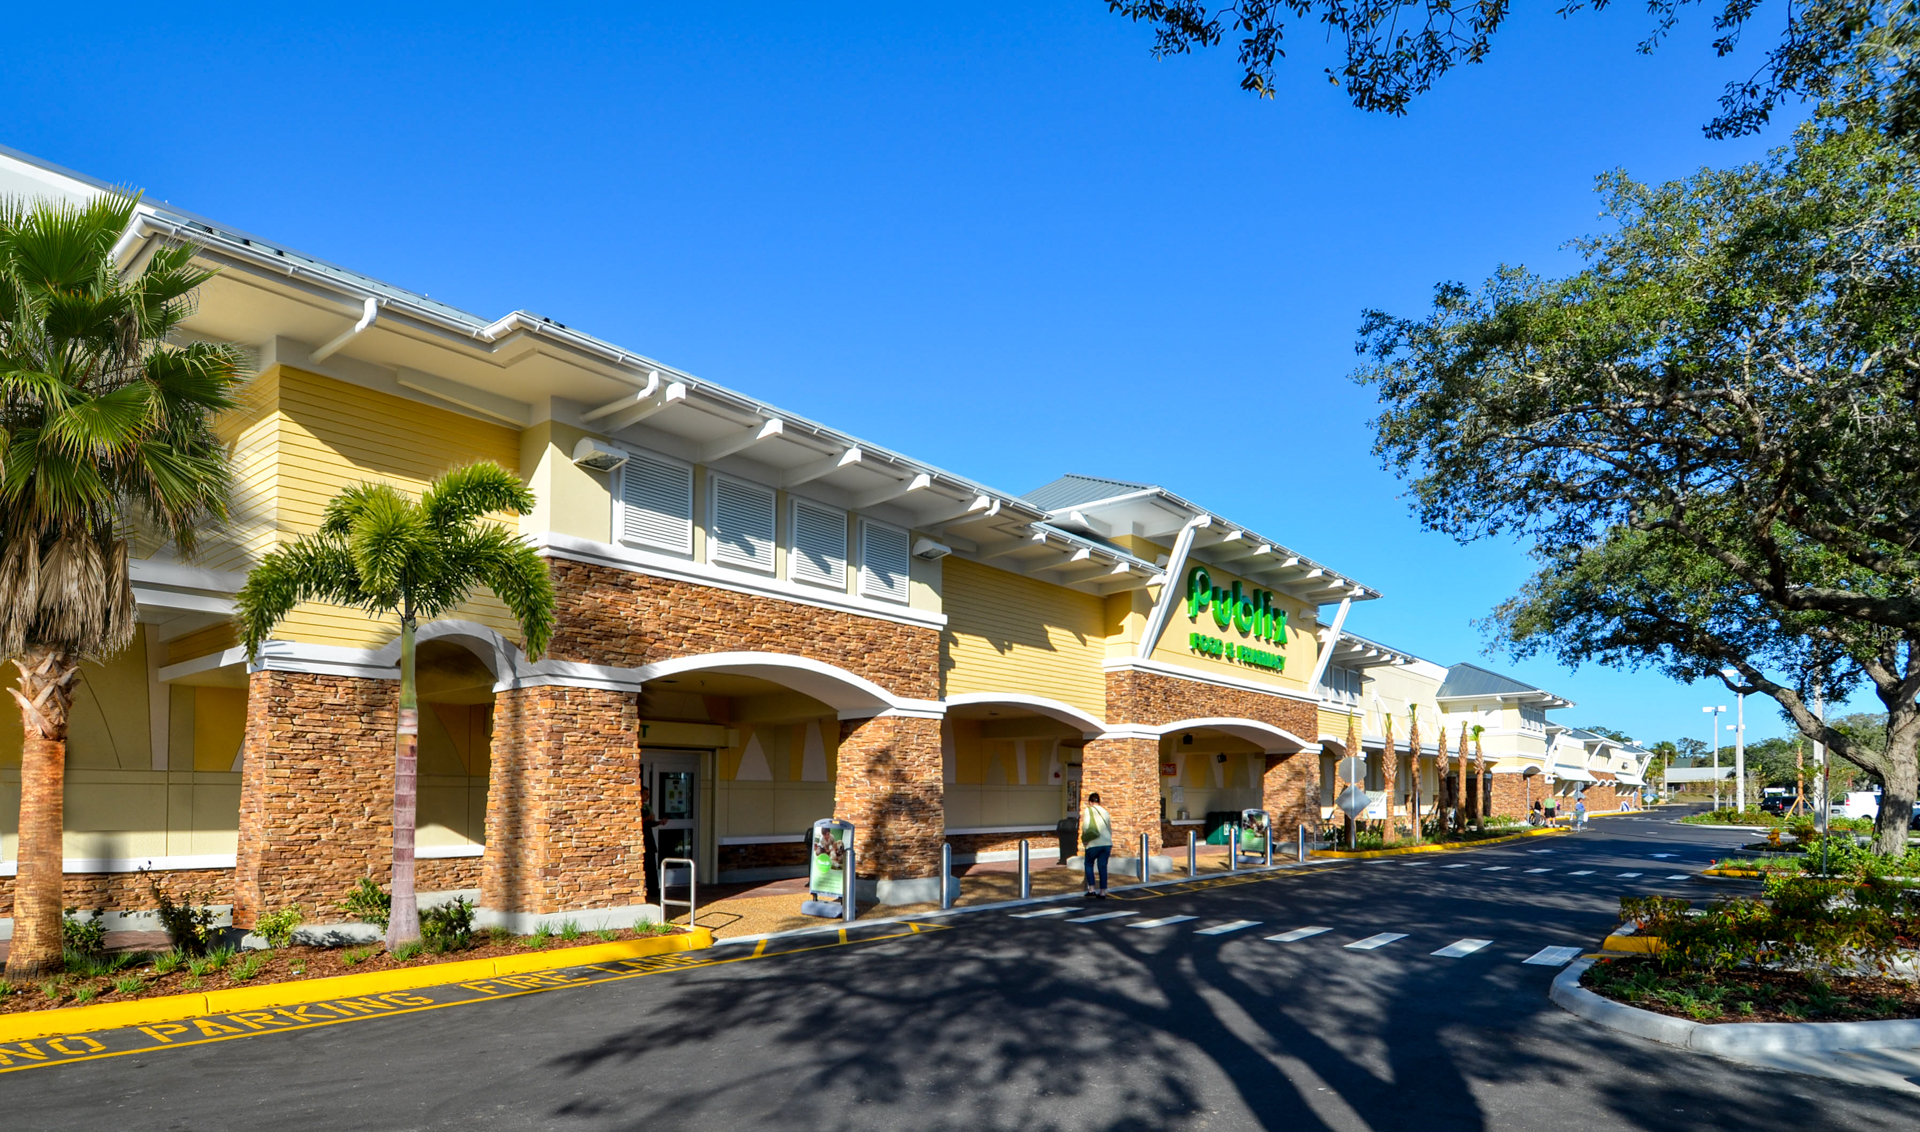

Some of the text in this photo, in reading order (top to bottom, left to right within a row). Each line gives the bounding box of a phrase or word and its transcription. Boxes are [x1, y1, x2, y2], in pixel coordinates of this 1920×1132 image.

[1187, 566, 1289, 645] Publix
[1189, 632, 1287, 671] FOOD & PHARMACY
[0, 953, 712, 1066] NO PARKING FIRE LANE
